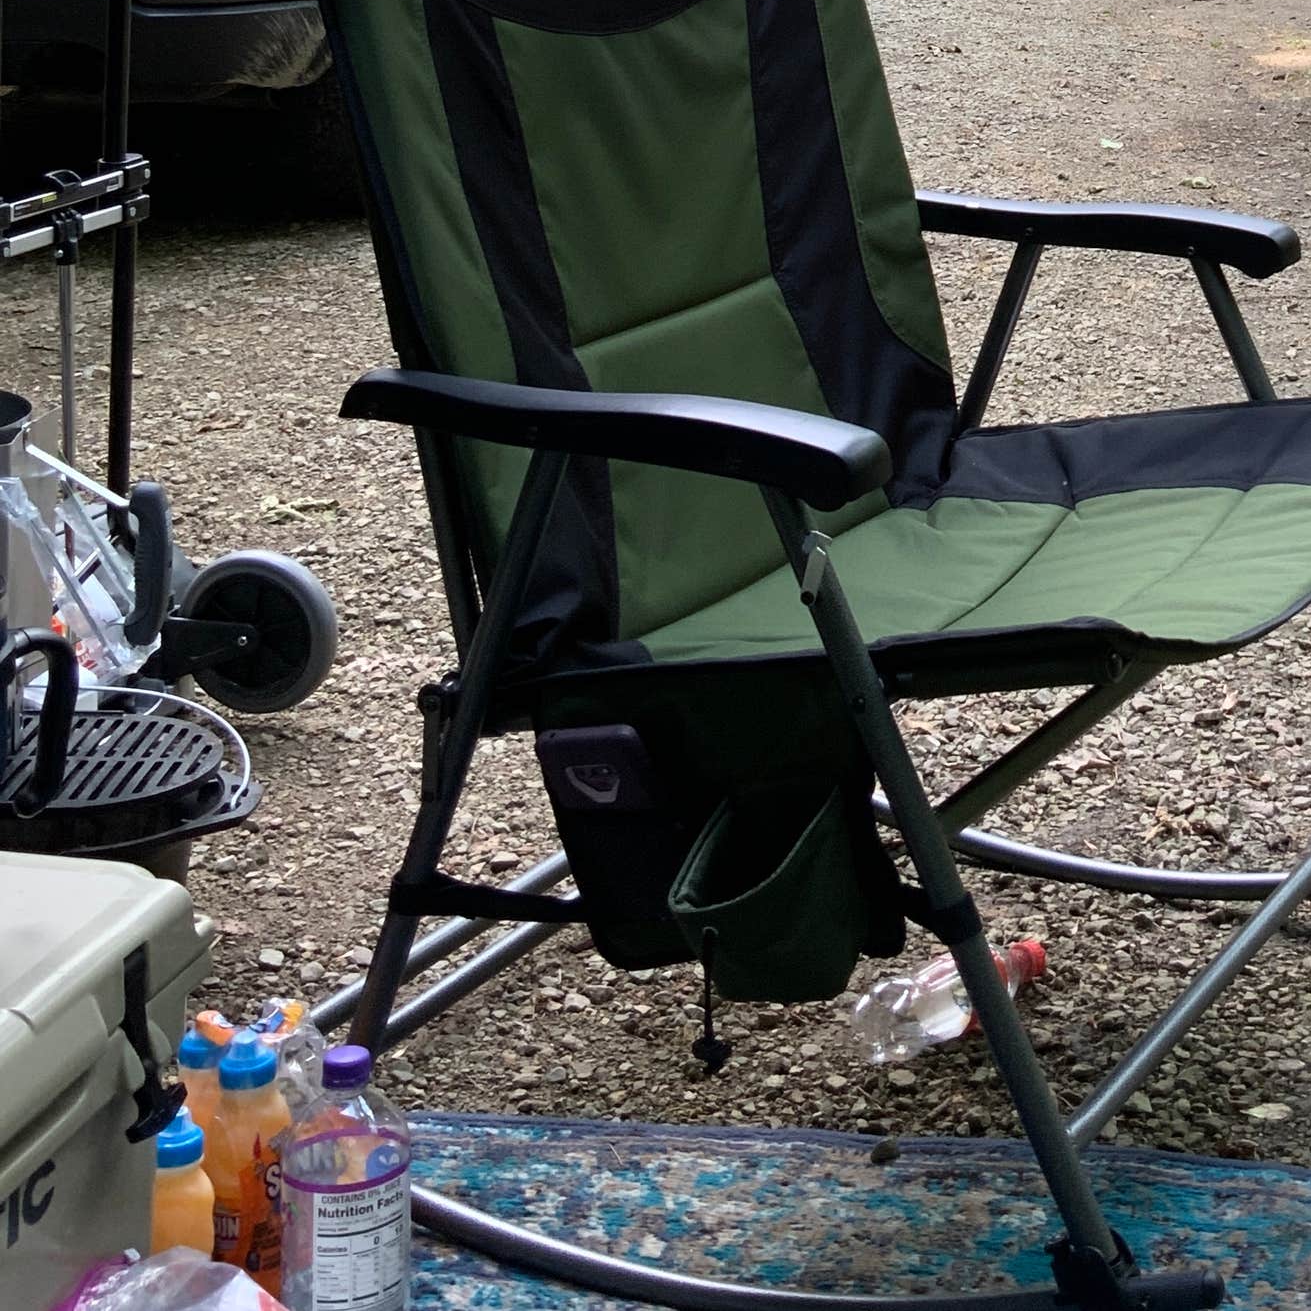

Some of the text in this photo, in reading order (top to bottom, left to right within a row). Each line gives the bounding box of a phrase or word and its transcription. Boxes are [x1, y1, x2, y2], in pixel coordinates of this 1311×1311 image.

[0, 1158, 56, 1249] IC
[318, 1191, 404, 1218] Nutrition Facts
[321, 1192, 366, 1204] CONTAINS
